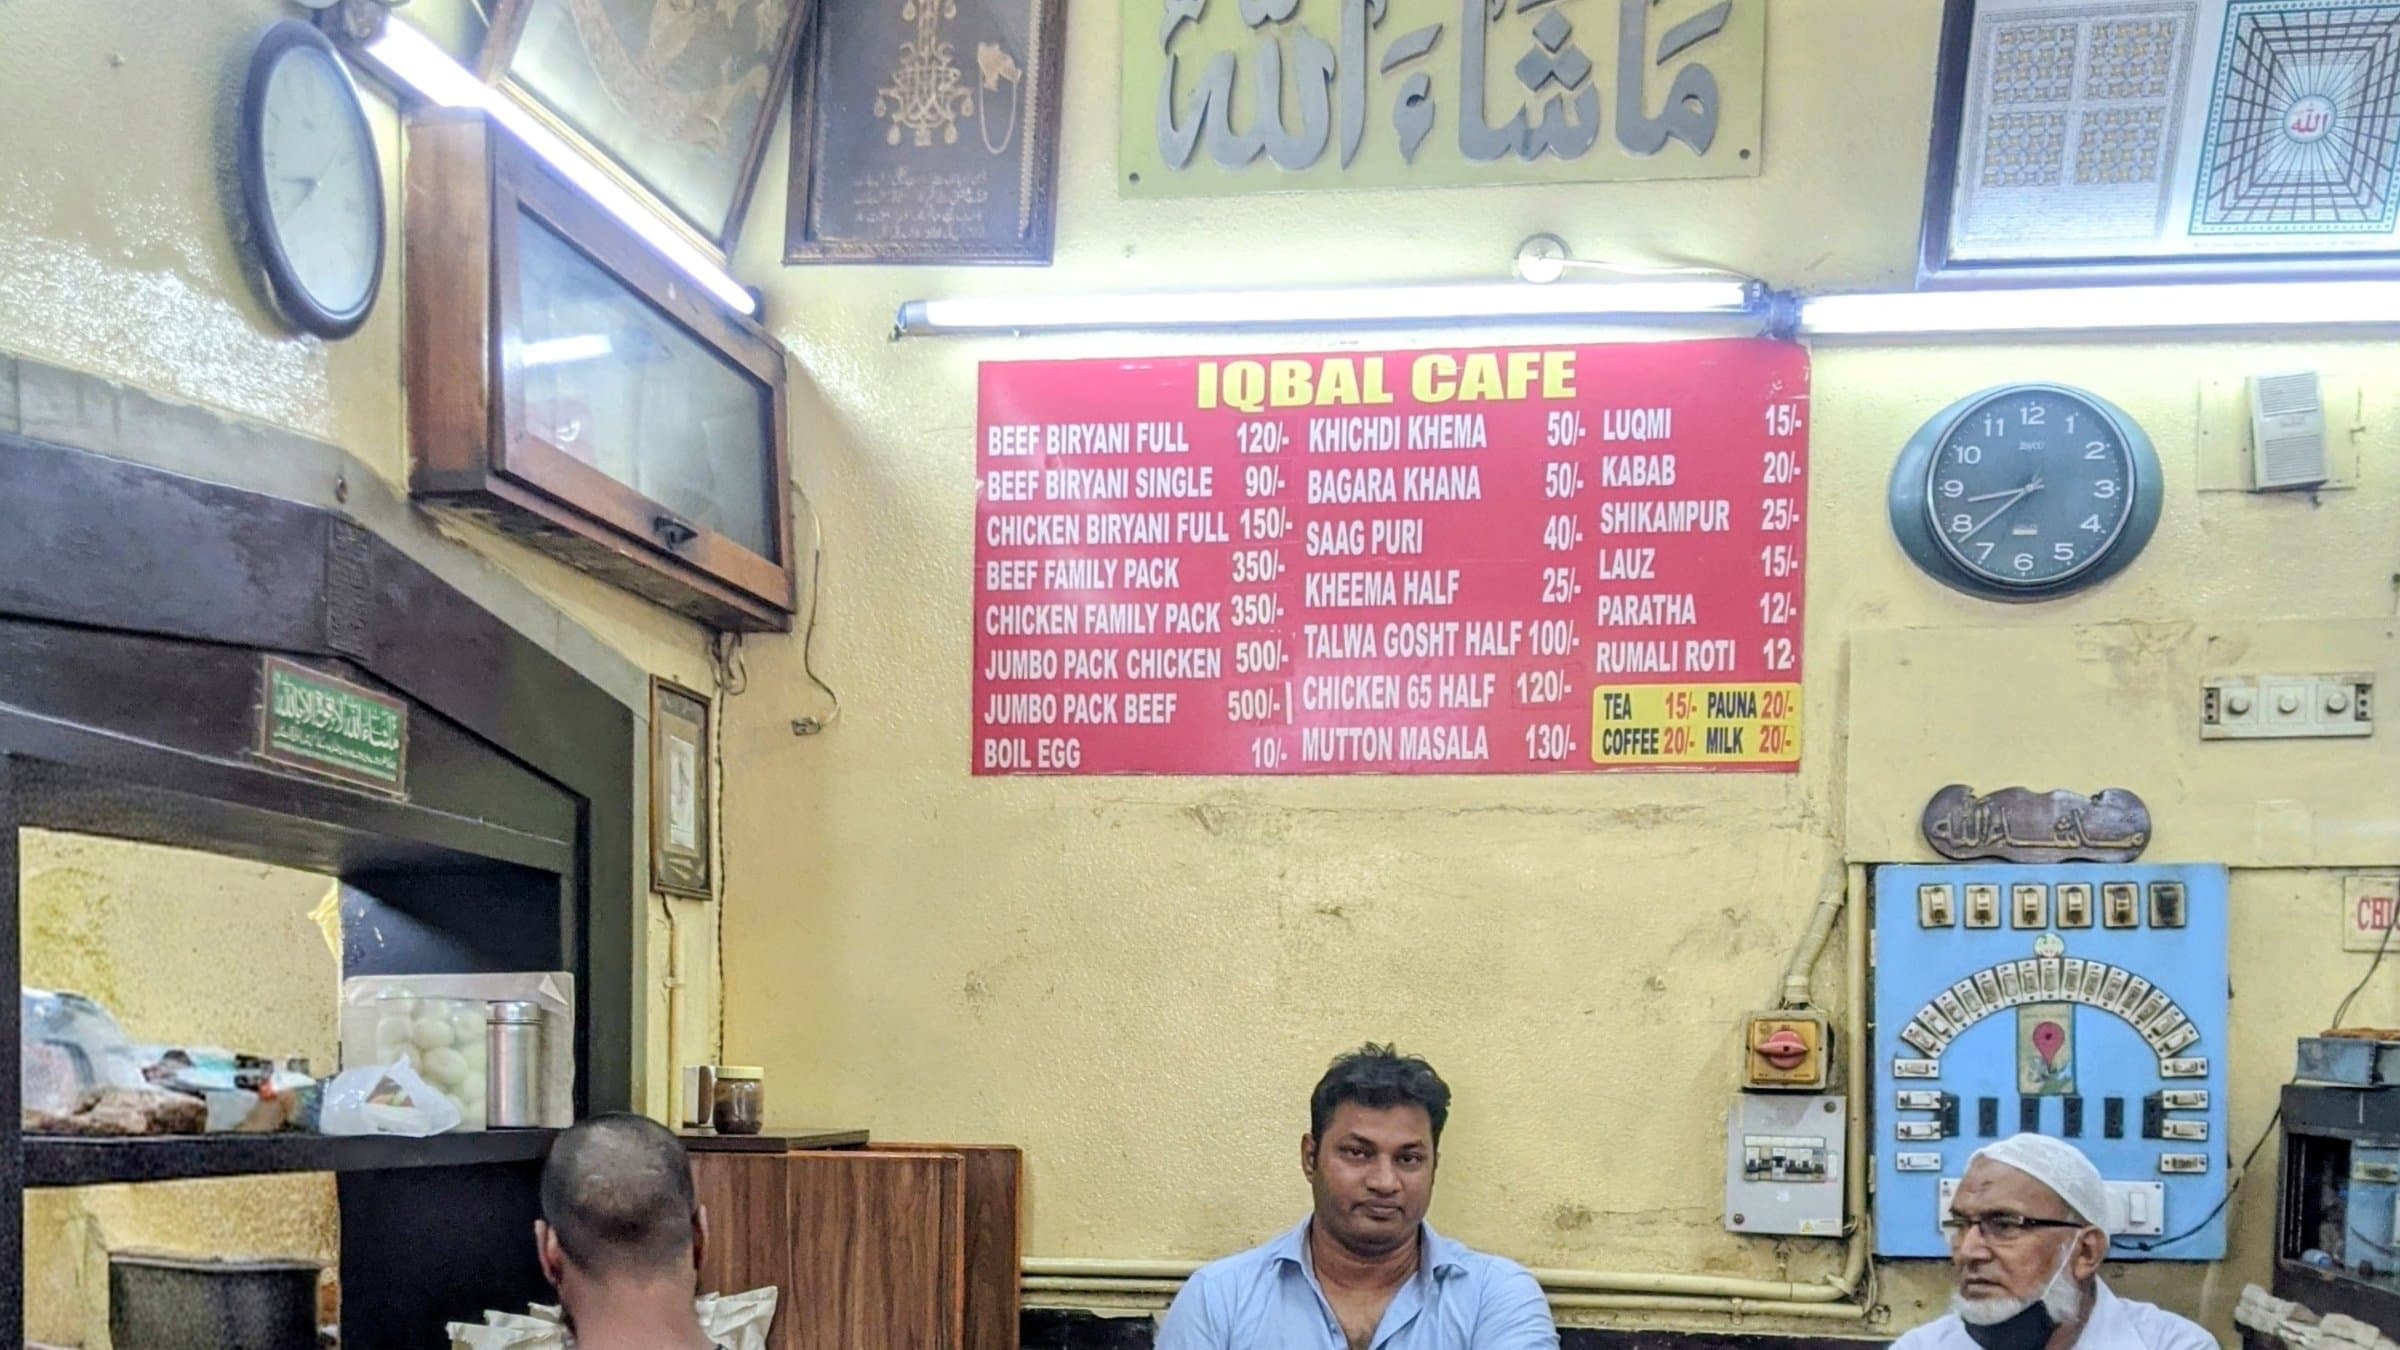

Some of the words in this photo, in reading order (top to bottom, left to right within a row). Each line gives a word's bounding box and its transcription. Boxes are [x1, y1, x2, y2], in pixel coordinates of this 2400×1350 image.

[1198, 358, 1392, 412] IQBAL
[1412, 352, 1576, 402] CAFE
[1310, 416, 1400, 452] KHICHDI
[1408, 414, 1486, 449] KHEMA
[1548, 411, 1585, 446] 50/-
[1604, 409, 1671, 440] LUQMI
[1766, 405, 1801, 435] 15/-
[1984, 416, 2004, 436] 11
[2020, 406, 2045, 425] 12
[2065, 416, 2075, 434] 1
[989, 423, 1039, 456] BEEF
[1046, 423, 1129, 454] BIRYANI
[1137, 422, 1188, 452] FULL
[1237, 422, 1289, 453] 120/-
[1956, 446, 1981, 464] 10
[2085, 441, 2105, 460] 2
[987, 470, 1038, 501] BEEF
[1045, 468, 1128, 499] BIRYANI
[1136, 467, 1212, 498] SINGLE
[1246, 466, 1284, 496] 90/-
[1308, 468, 1396, 503] BAGARA
[1404, 466, 1480, 501] KHANA
[1546, 463, 1583, 497] 50/-
[1603, 455, 1675, 486] KABAB
[1764, 452, 1800, 483] 20/-
[1944, 480, 1963, 498] 9
[2094, 480, 2115, 498] 3
[988, 514, 1079, 545] CHICKEN
[1087, 513, 1169, 544] BIRYANI
[1178, 512, 1228, 542] FULL
[1241, 507, 1292, 538] 150/-
[1601, 501, 1729, 533] SHIKAMPUR
[1762, 499, 1799, 529] 25/-
[1952, 515, 1972, 533] 8
[2080, 515, 2101, 532] 4
[1307, 520, 1364, 556] SAAG
[1372, 520, 1422, 553] PURI
[1544, 516, 1582, 550] 40/-
[1976, 542, 1995, 560] 7
[2055, 543, 2074, 560] 5
[988, 561, 1037, 589] BEEF
[1044, 560, 1117, 589] FAMILY
[1125, 558, 1178, 588] PACK
[1233, 550, 1284, 582] 350/-
[1600, 549, 1654, 579] LAUZ
[1762, 546, 1797, 576] 15/-
[2014, 554, 2034, 570] 6
[1306, 572, 1396, 606] KHEEMA
[1404, 570, 1459, 604] HALF
[1543, 568, 1580, 602] 25/-
[987, 604, 1078, 634] CHICKEN
[1085, 603, 1158, 633] FAMILY
[1166, 603, 1220, 632] PACK
[1232, 594, 1283, 625] 350/-
[1599, 595, 1695, 625] PARATHA
[1761, 593, 1795, 623] 12/-
[1304, 624, 1376, 658] TALWA
[1384, 623, 1459, 657] GOSHT
[1466, 621, 1522, 655] HALF
[1529, 621, 1579, 655] 100/-
[1597, 642, 1677, 672] RUMALI
[1686, 640, 1734, 671] ROTI
[986, 650, 1057, 679] JUMBO
[1065, 649, 1117, 678] PACK
[1127, 648, 1220, 678] CHICKEN
[1237, 640, 1288, 672] 500/-
[986, 695, 1056, 723] JUMBO
[1064, 694, 1117, 723] PACK
[1125, 694, 1176, 723] BEEF
[1229, 689, 1280, 720] 500/-
[1303, 675, 1400, 710] CHICKEN
[1407, 675, 1432, 709] 65
[1439, 674, 1495, 707] HALF
[1517, 671, 1571, 703] 120/-
[1604, 693, 1631, 720] TEA
[1665, 691, 1696, 720] 15/-
[1708, 692, 1756, 718] PAUNA
[1762, 691, 1793, 718] 20/-
[986, 739, 1030, 767] BOIL
[1039, 739, 1079, 767] EGG
[1252, 738, 1287, 768] 10/-
[1303, 727, 1392, 761] MUTTON
[1400, 726, 1488, 760] MASALA
[1526, 725, 1575, 759] 130/-
[1603, 727, 1658, 755] COFFEE
[1664, 726, 1695, 755] 20/-
[1706, 726, 1743, 754] MILK
[1759, 724, 1791, 754] 20/-
